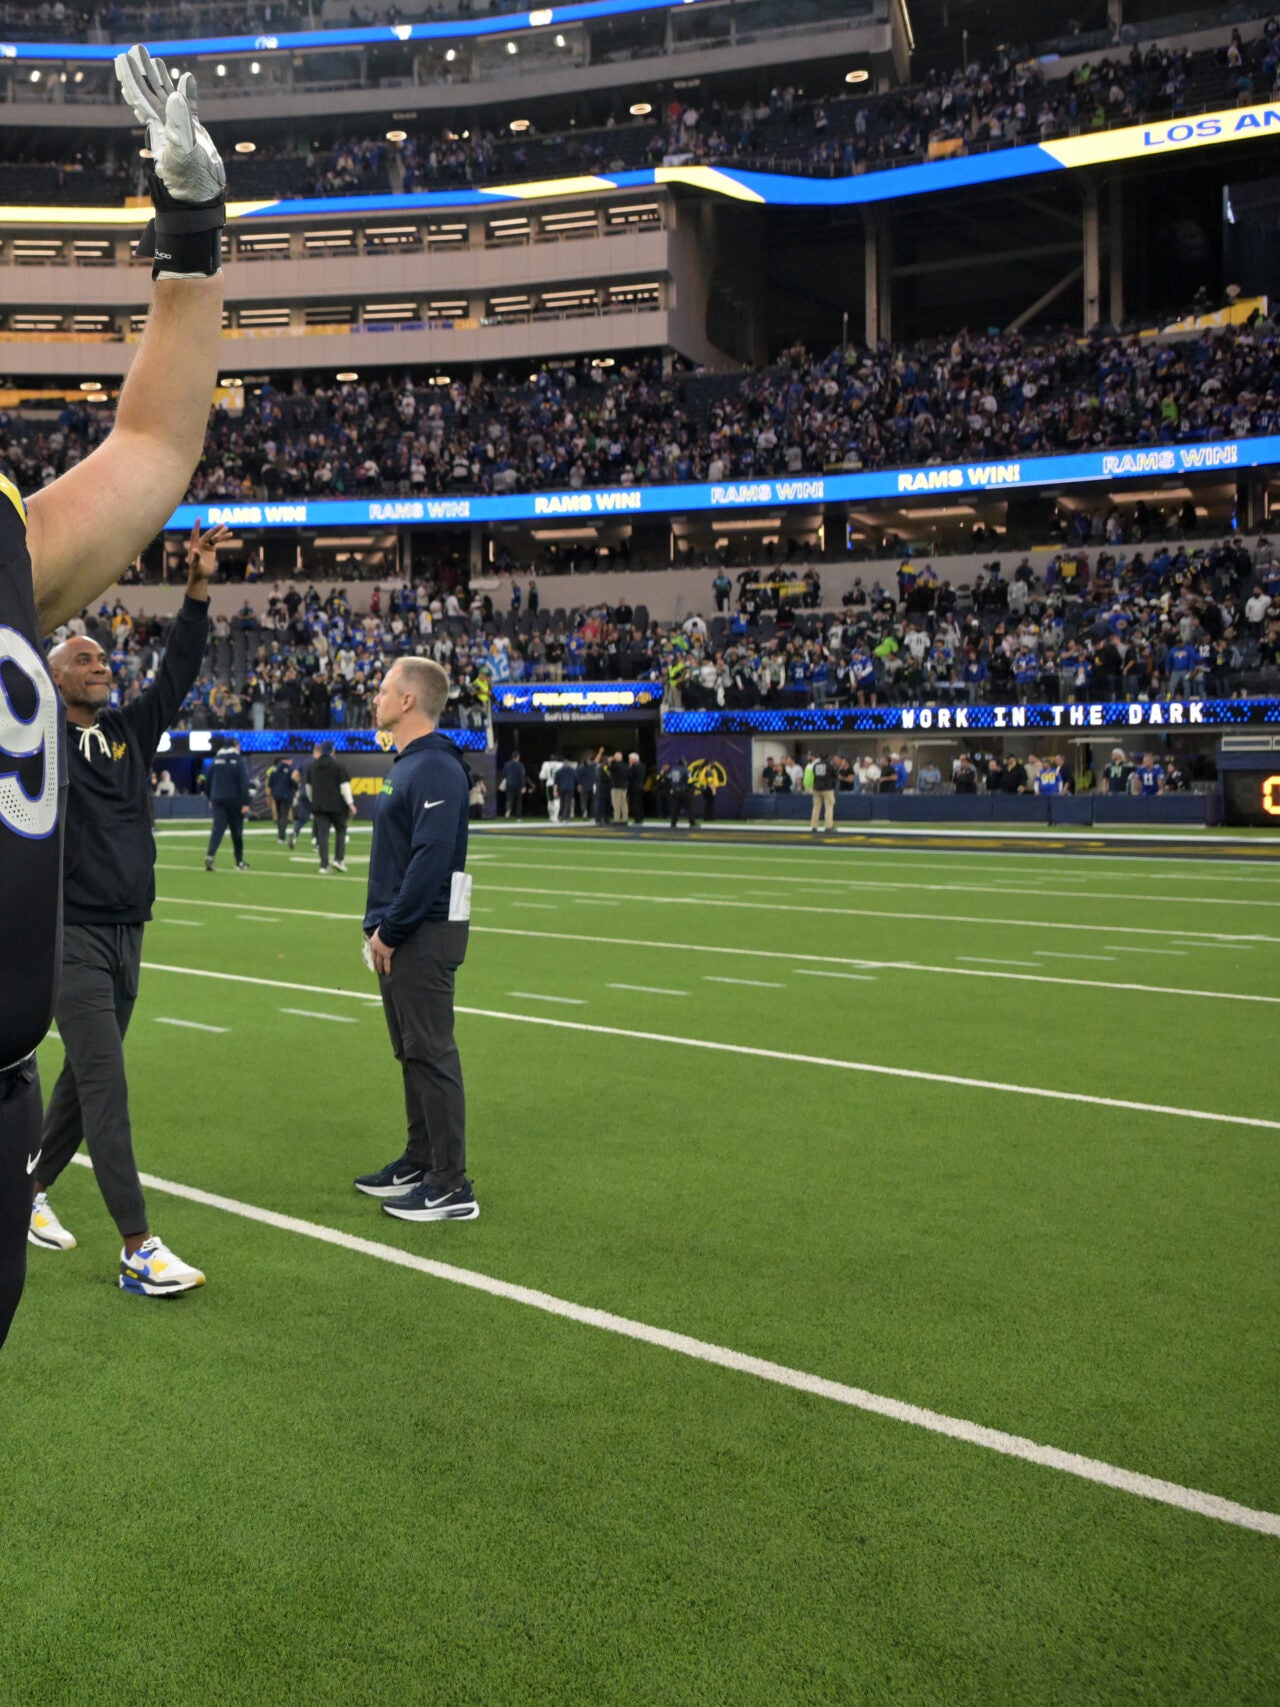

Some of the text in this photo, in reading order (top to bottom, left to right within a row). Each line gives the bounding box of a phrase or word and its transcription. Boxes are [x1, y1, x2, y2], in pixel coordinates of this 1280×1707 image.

[1144, 119, 1223, 146] LOS
[1103, 445, 1238, 475] RAMS WIN!
[898, 464, 1021, 492] RAMS WIN!
[535, 491, 641, 514] RAMS WIN!
[710, 481, 824, 504] RAMS WIN!
[208, 506, 306, 524] RAMS WIN!
[369, 501, 470, 520] RAMS WIN!
[571, 711, 605, 722] Stadium
[901, 702, 1204, 728] WORK IN THE DARK
